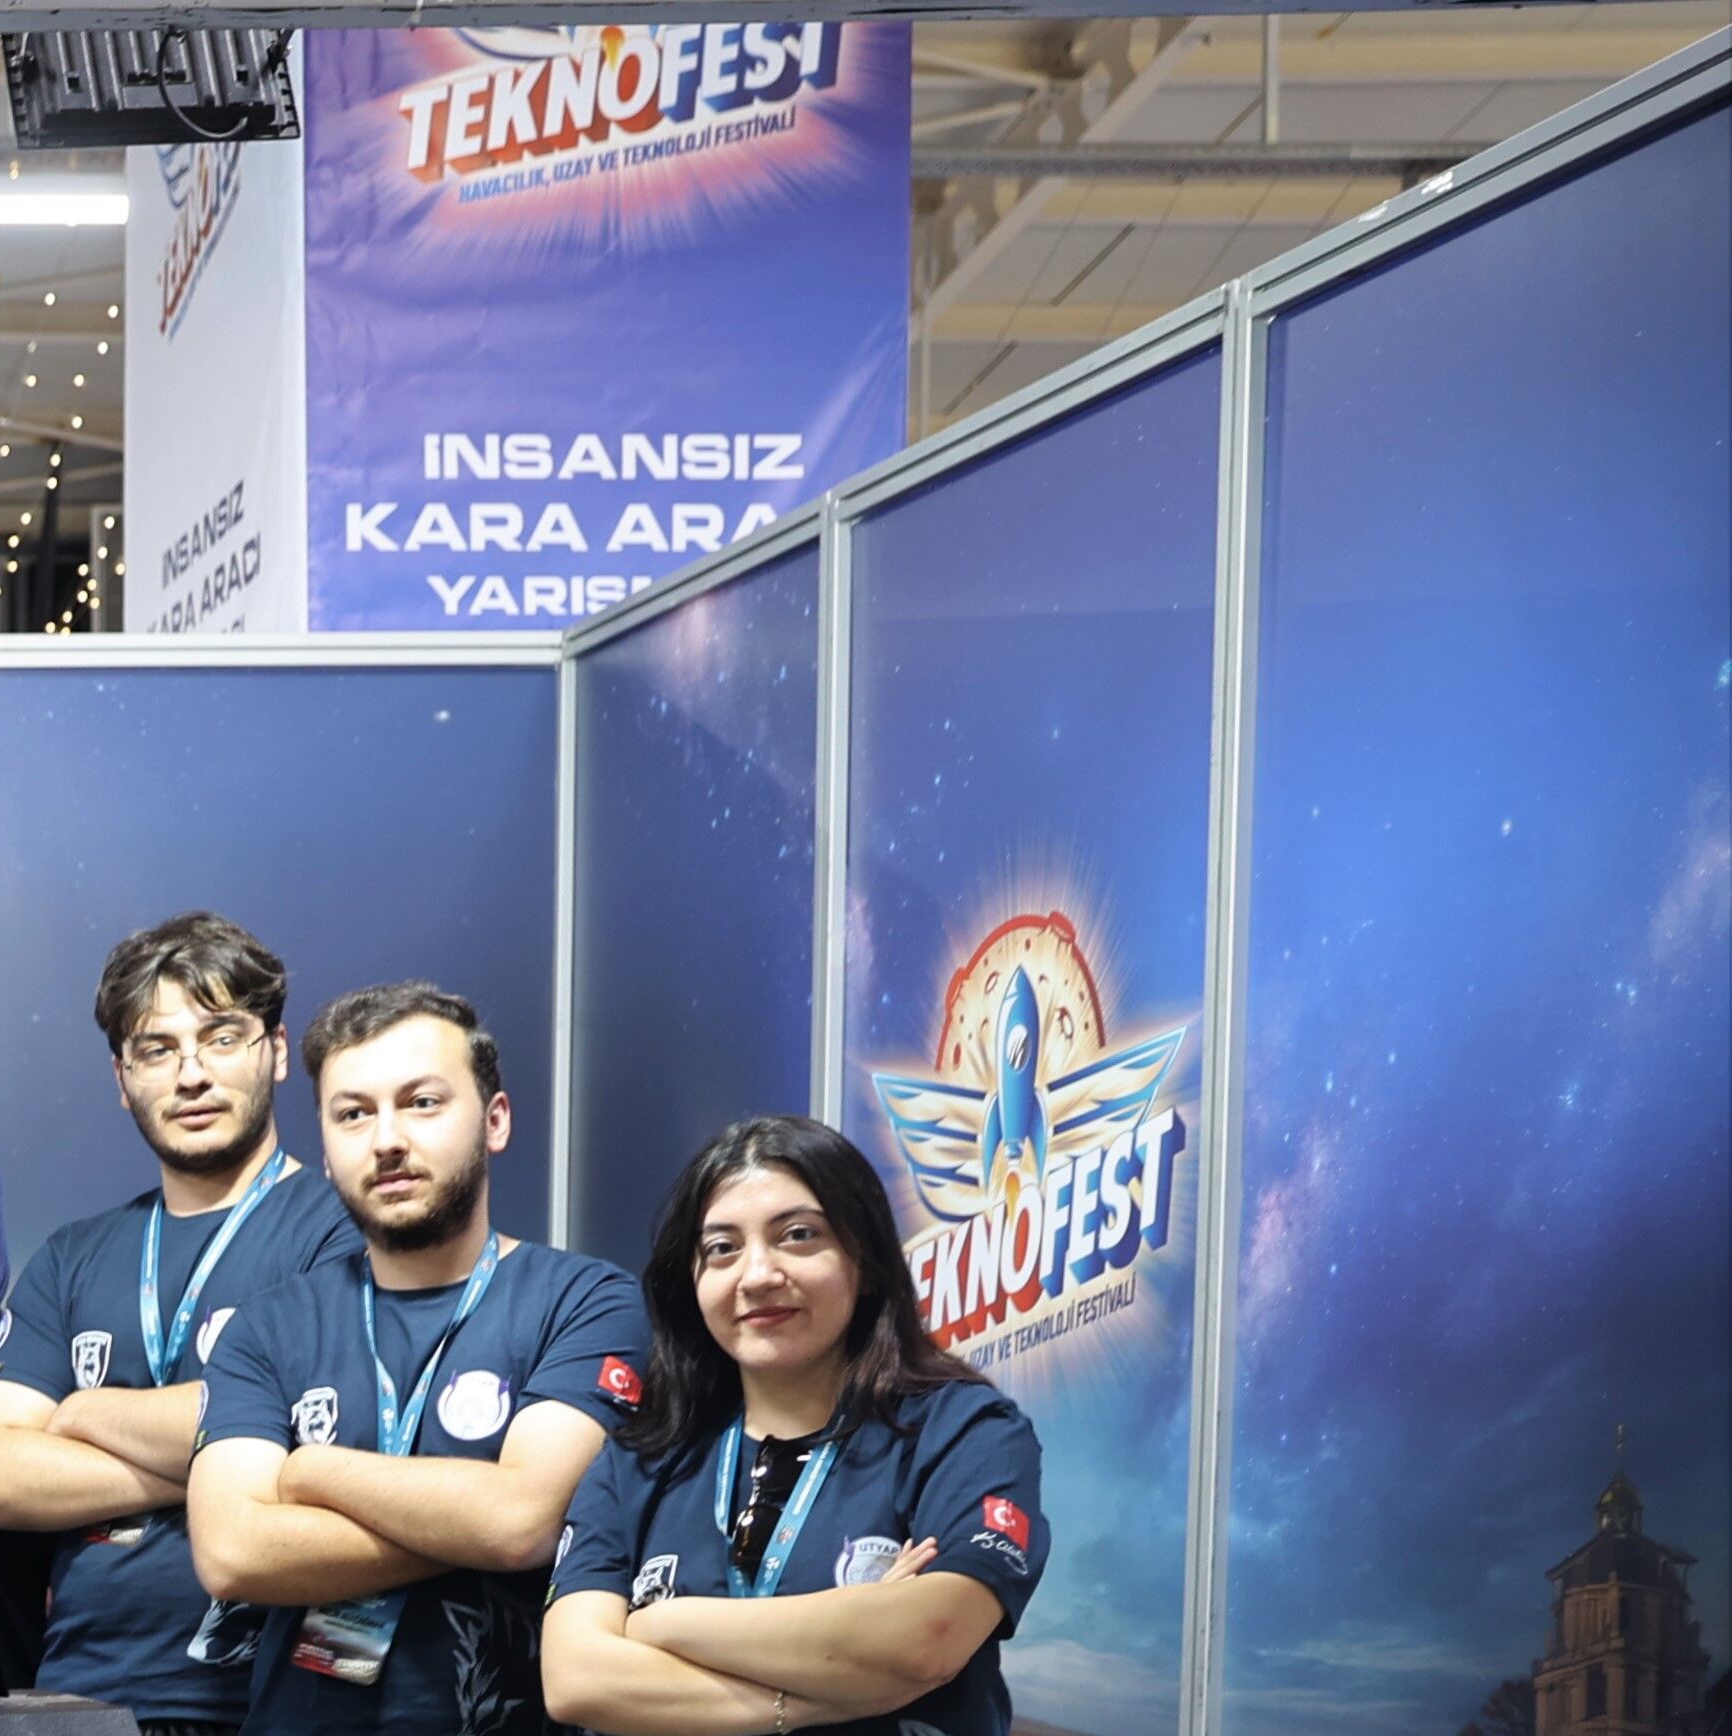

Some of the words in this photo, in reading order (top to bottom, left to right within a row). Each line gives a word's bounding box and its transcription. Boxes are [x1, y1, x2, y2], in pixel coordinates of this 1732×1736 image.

[399, 22, 842, 184] TEKNOFEST
[458, 168, 551, 203] HAVACILIK,
[553, 157, 593, 183] UZAY
[597, 147, 619, 171] VE
[623, 127, 713, 167] TEKNOLOJİ
[714, 106, 797, 147] FESTİVALİ
[424, 433, 804, 480] İNSANSIZ
[346, 503, 588, 552] KARA
[606, 503, 778, 551] ARA
[199, 531, 261, 622] ARACI
[908, 1105, 1185, 1349] EKNOFEST
[998, 1333, 1013, 1362] VE
[1013, 1303, 1076, 1357] TEKNOLOJİ
[1076, 1271, 1137, 1329] FESTİVALİ
